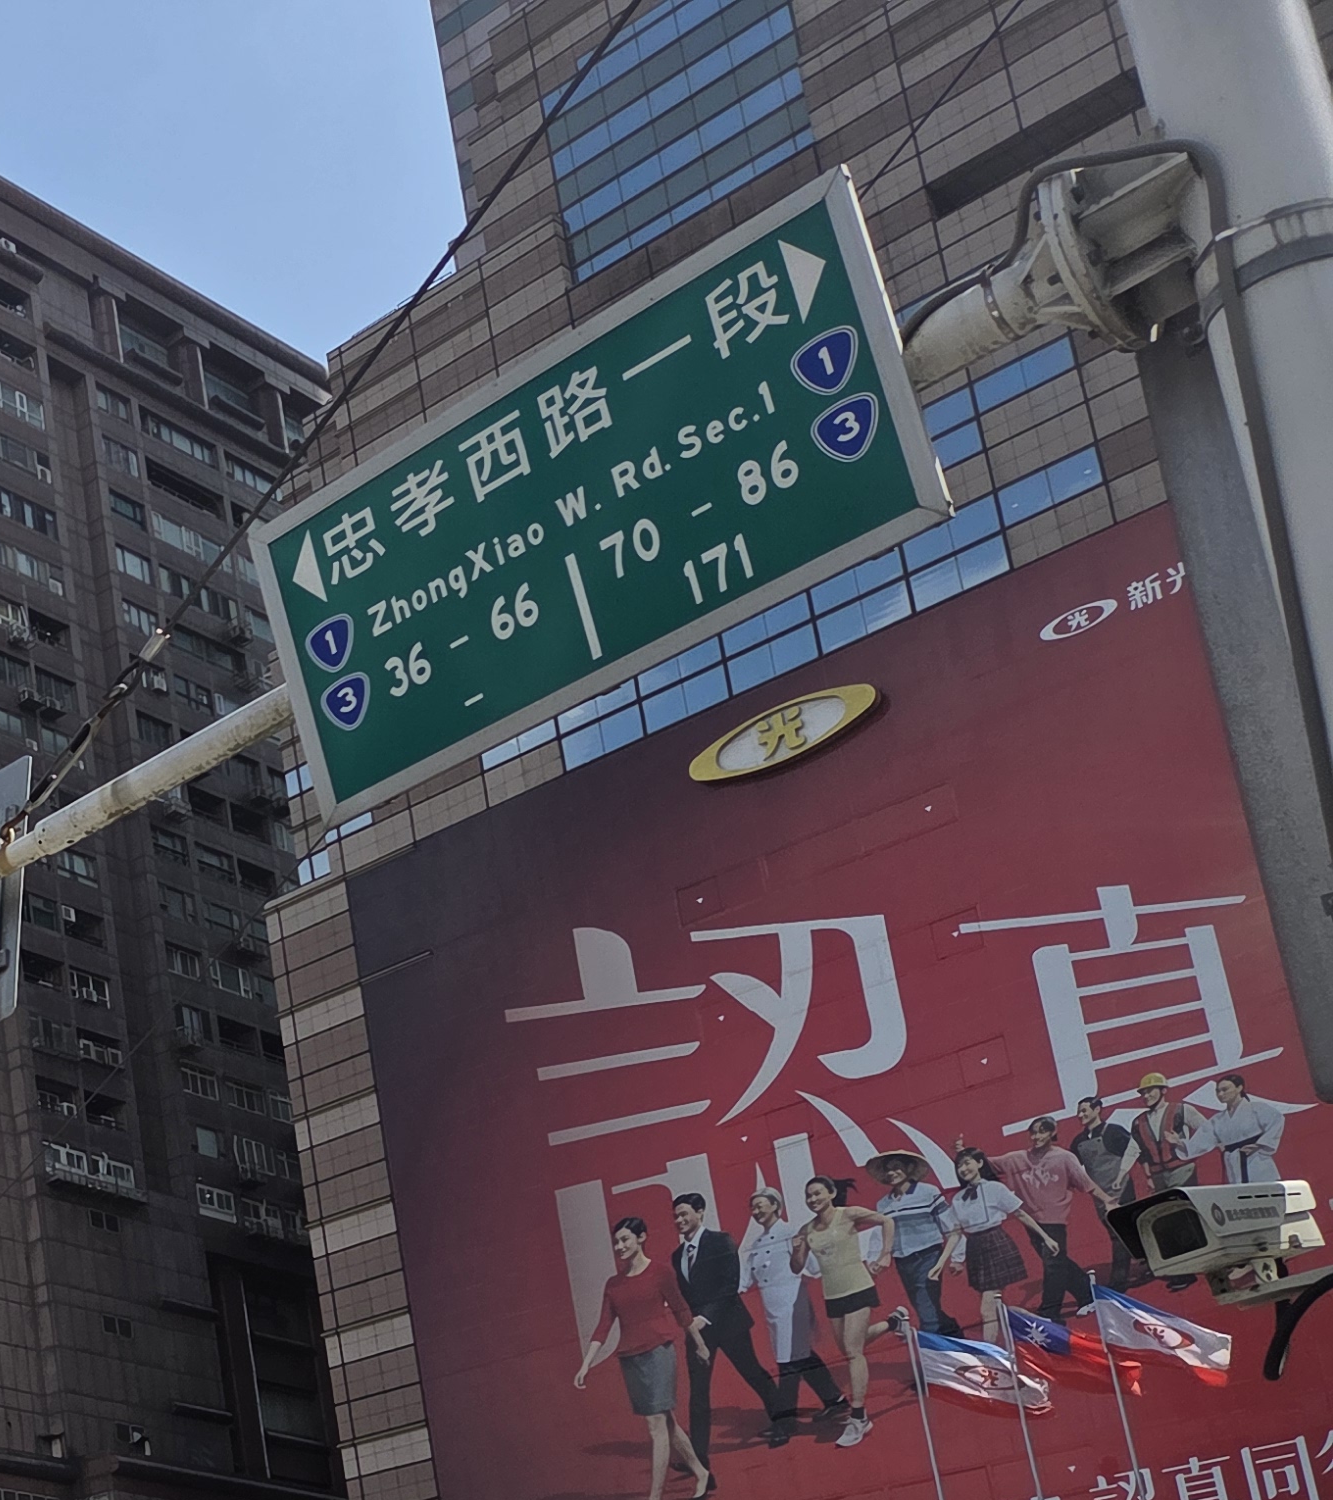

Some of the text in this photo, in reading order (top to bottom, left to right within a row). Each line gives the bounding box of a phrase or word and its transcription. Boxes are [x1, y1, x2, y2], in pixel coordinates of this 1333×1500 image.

[816, 346, 835, 375] 1
[321, 260, 790, 586] 忠孝西路一段
[833, 411, 860, 443] 3
[367, 523, 544, 637] ZhongXiao
[555, 486, 602, 527] W.
[610, 444, 673, 498] Rd.
[600, 518, 661, 579] 70
[737, 440, 800, 506] 86
[683, 533, 754, 605] 171
[384, 641, 432, 699] 36
[490, 581, 540, 640] 66
